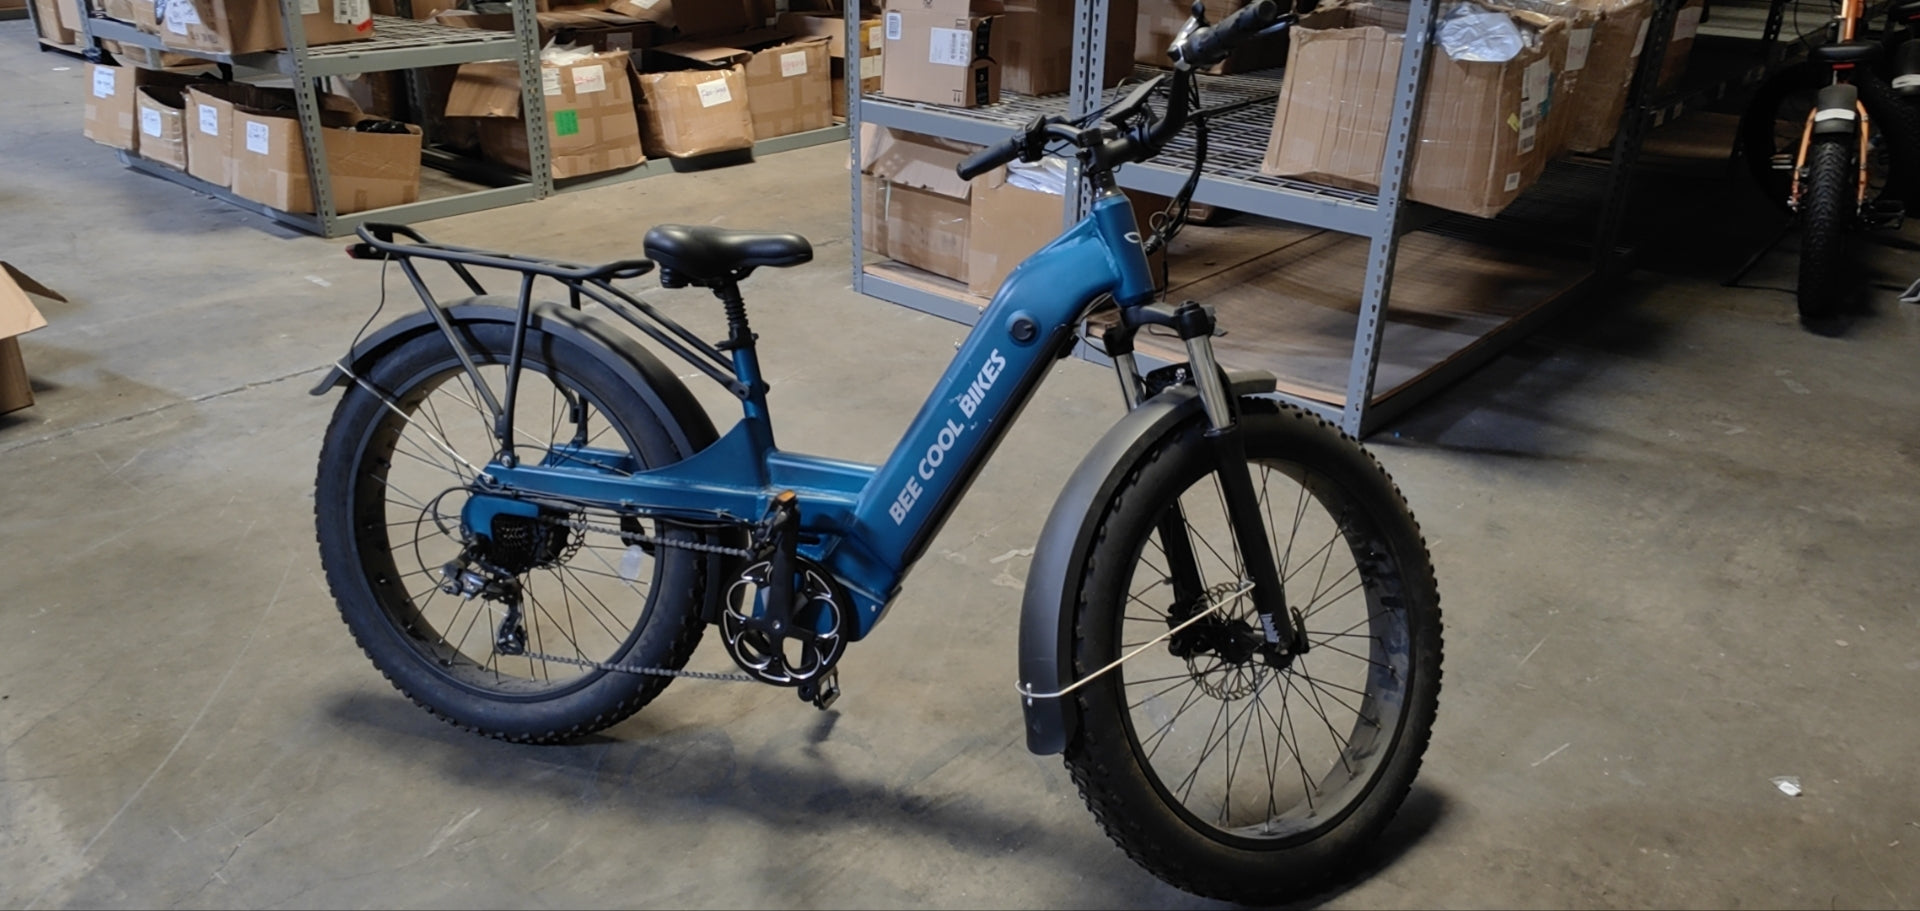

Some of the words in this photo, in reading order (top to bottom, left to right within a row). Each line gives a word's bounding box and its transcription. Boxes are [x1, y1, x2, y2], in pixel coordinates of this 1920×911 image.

[888, 475, 924, 526] BEE
[918, 418, 965, 481] COOL
[958, 348, 1007, 419] BIKES
